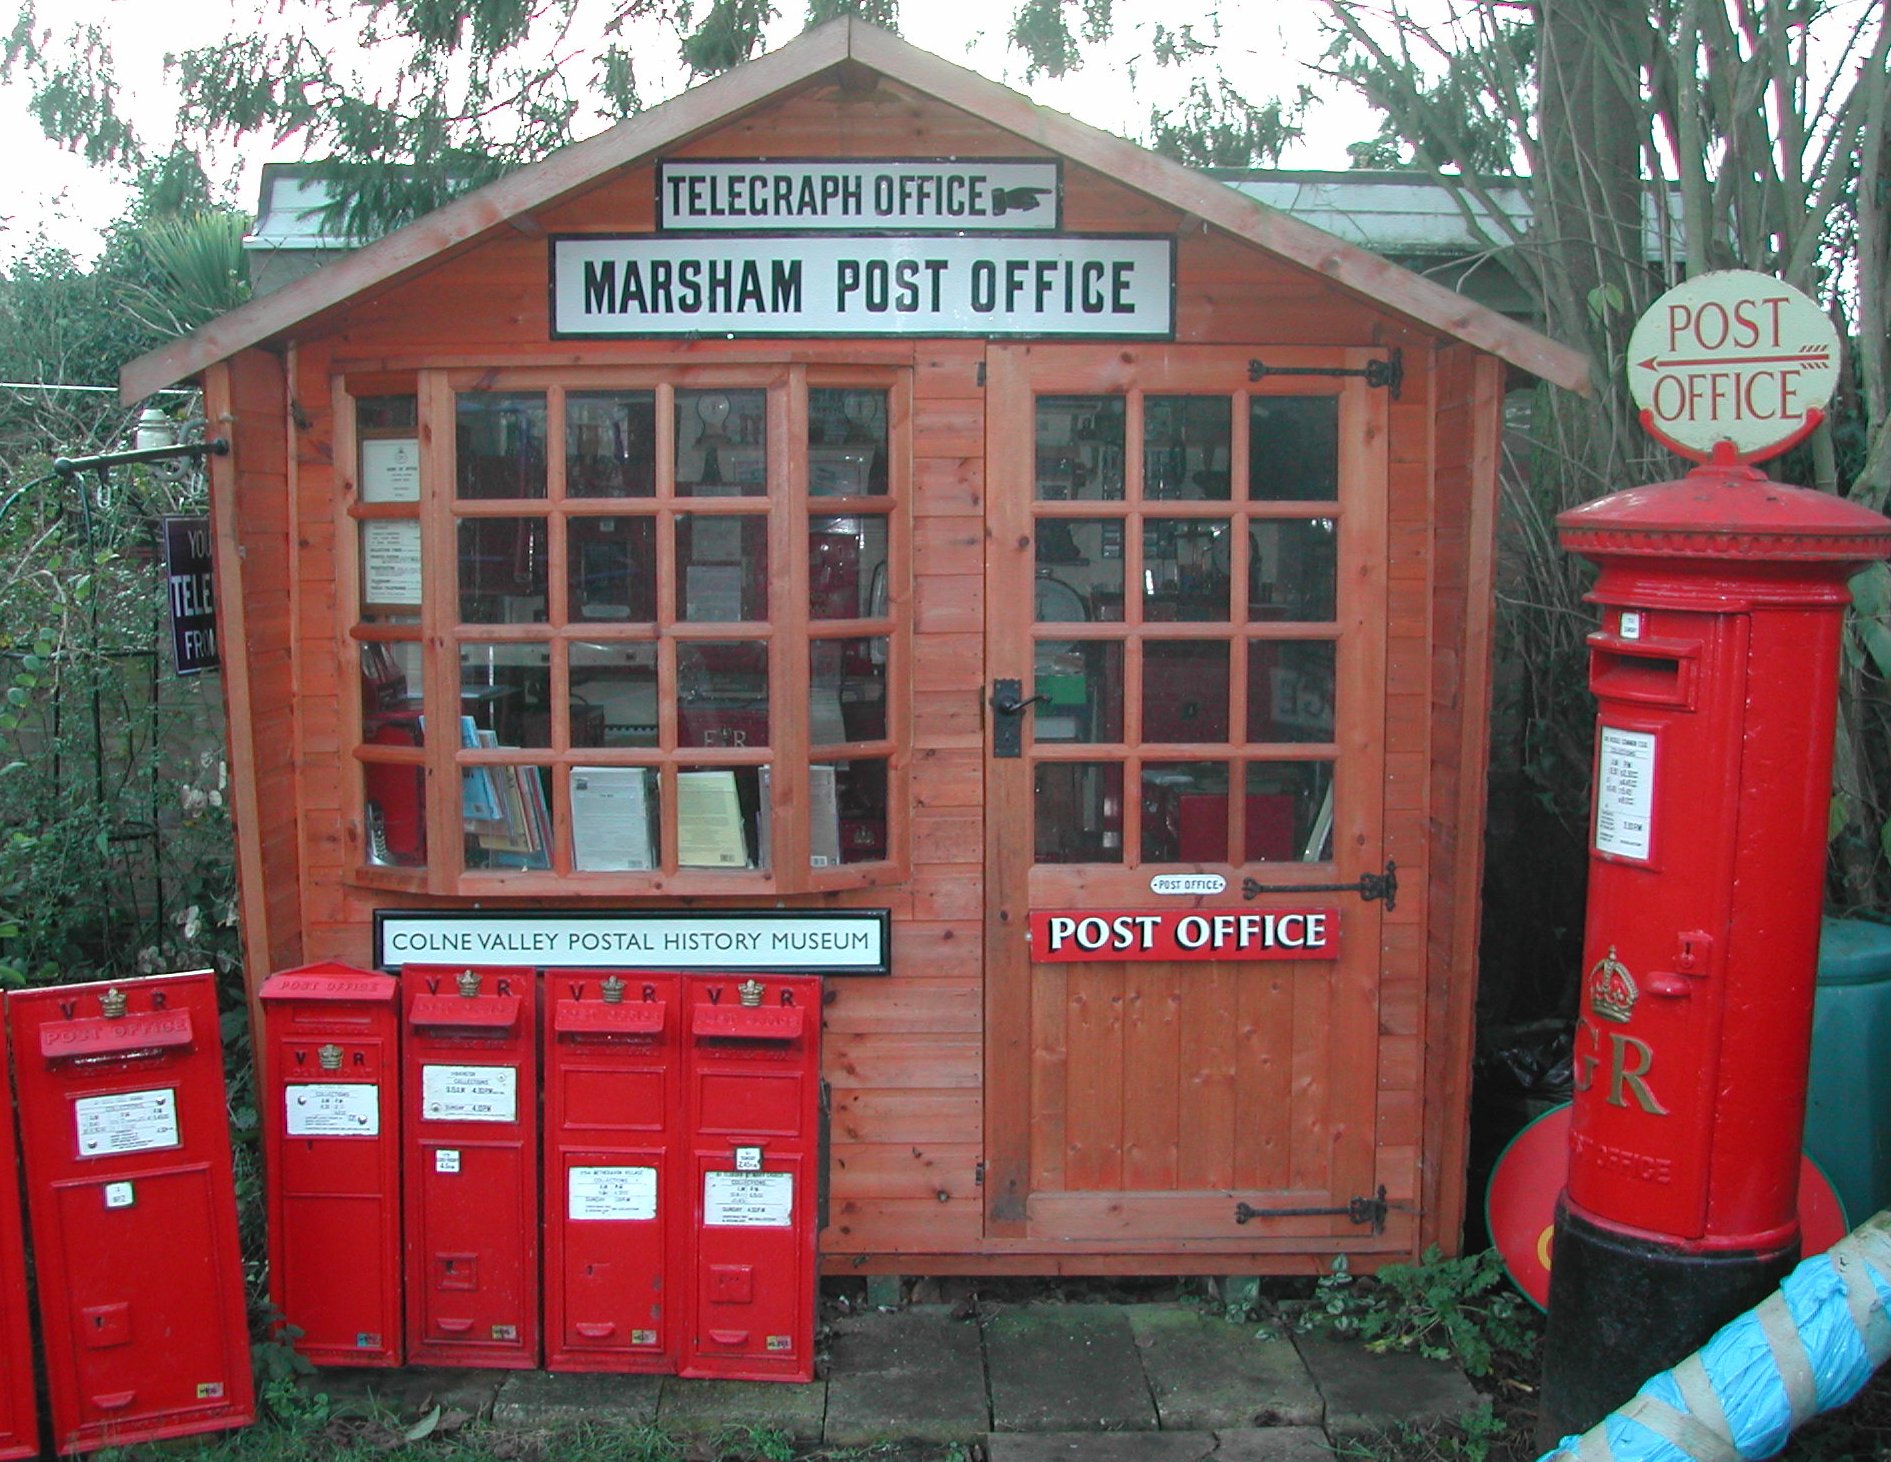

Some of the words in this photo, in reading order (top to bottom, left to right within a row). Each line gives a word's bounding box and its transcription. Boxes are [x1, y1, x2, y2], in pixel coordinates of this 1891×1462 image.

[667, 174, 862, 216] TELEGRAPH
[874, 174, 988, 216] OFFICE
[583, 259, 803, 315] MARSHAM
[836, 259, 949, 314] POST
[971, 259, 1136, 314] OFFICE
[1668, 297, 1791, 353] POST
[1652, 369, 1804, 422] OFFICE
[170, 574, 213, 618] TELE
[1158, 878, 1182, 891] POST
[1183, 878, 1220, 890] OFFICE
[392, 931, 473, 951] COLNE
[477, 932, 561, 951] VALLEY
[567, 932, 654, 951] POSTAL
[664, 932, 763, 951] HISTORY
[771, 931, 870, 951] MUSEUM
[1047, 916, 1162, 953] POST
[1173, 914, 1327, 952] OFFICE
[281, 980, 320, 992] POST
[425, 976, 442, 995] V
[496, 977, 513, 997] R
[568, 981, 586, 1001] V
[641, 981, 658, 1002] R
[705, 985, 724, 1005] V
[779, 986, 797, 1007] R
[45, 1025, 103, 1046] POST
[112, 1016, 189, 1039] OFFICE
[295, 1051, 307, 1066] V
[353, 1050, 366, 1066] R
[1596, 1145, 1672, 1183] OFFICE
